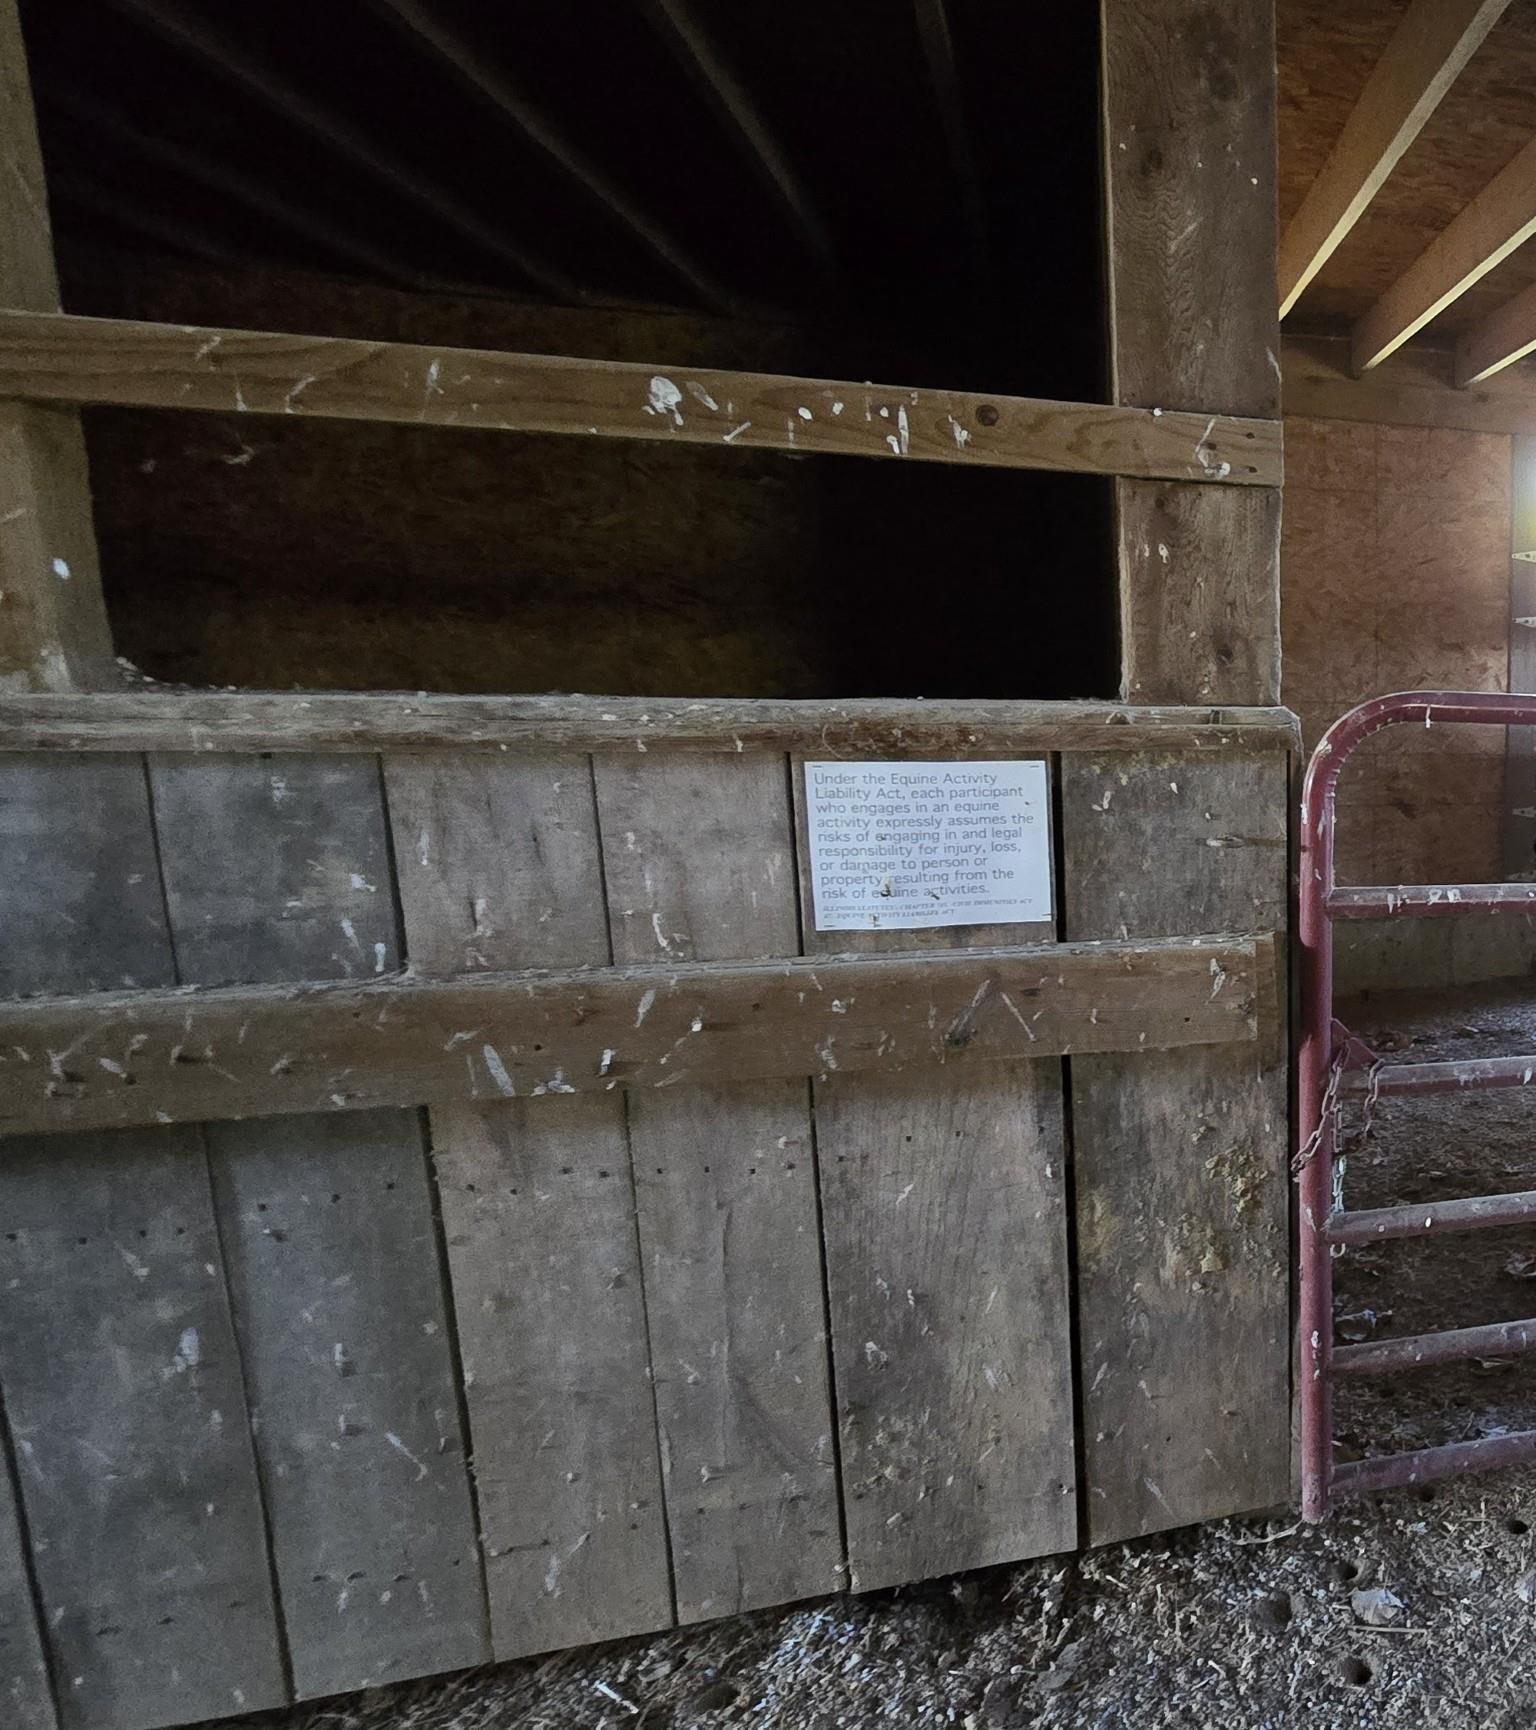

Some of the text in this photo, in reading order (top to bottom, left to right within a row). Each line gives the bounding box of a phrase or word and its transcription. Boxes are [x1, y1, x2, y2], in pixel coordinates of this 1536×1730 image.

[814, 773, 997, 788] Under the Equine Activity
[815, 786, 1023, 800] Liability Act, each participant
[816, 802, 999, 816] who engages in an equine
[817, 814, 1034, 830] activity expressly assumes the
[856, 831, 870, 842] of
[875, 830, 940, 842] engaging
[945, 829, 957, 840] in
[962, 828, 986, 839] and
[992, 827, 1022, 839] legal
[818, 845, 913, 858] responsibility
[919, 844, 939, 855] for
[820, 856, 988, 873] or damage to person or
[821, 874, 882, 887] property
[955, 870, 987, 880] from
[993, 869, 1014, 879] the
[822, 887, 848, 899] risk
[852, 886, 867, 898] of
